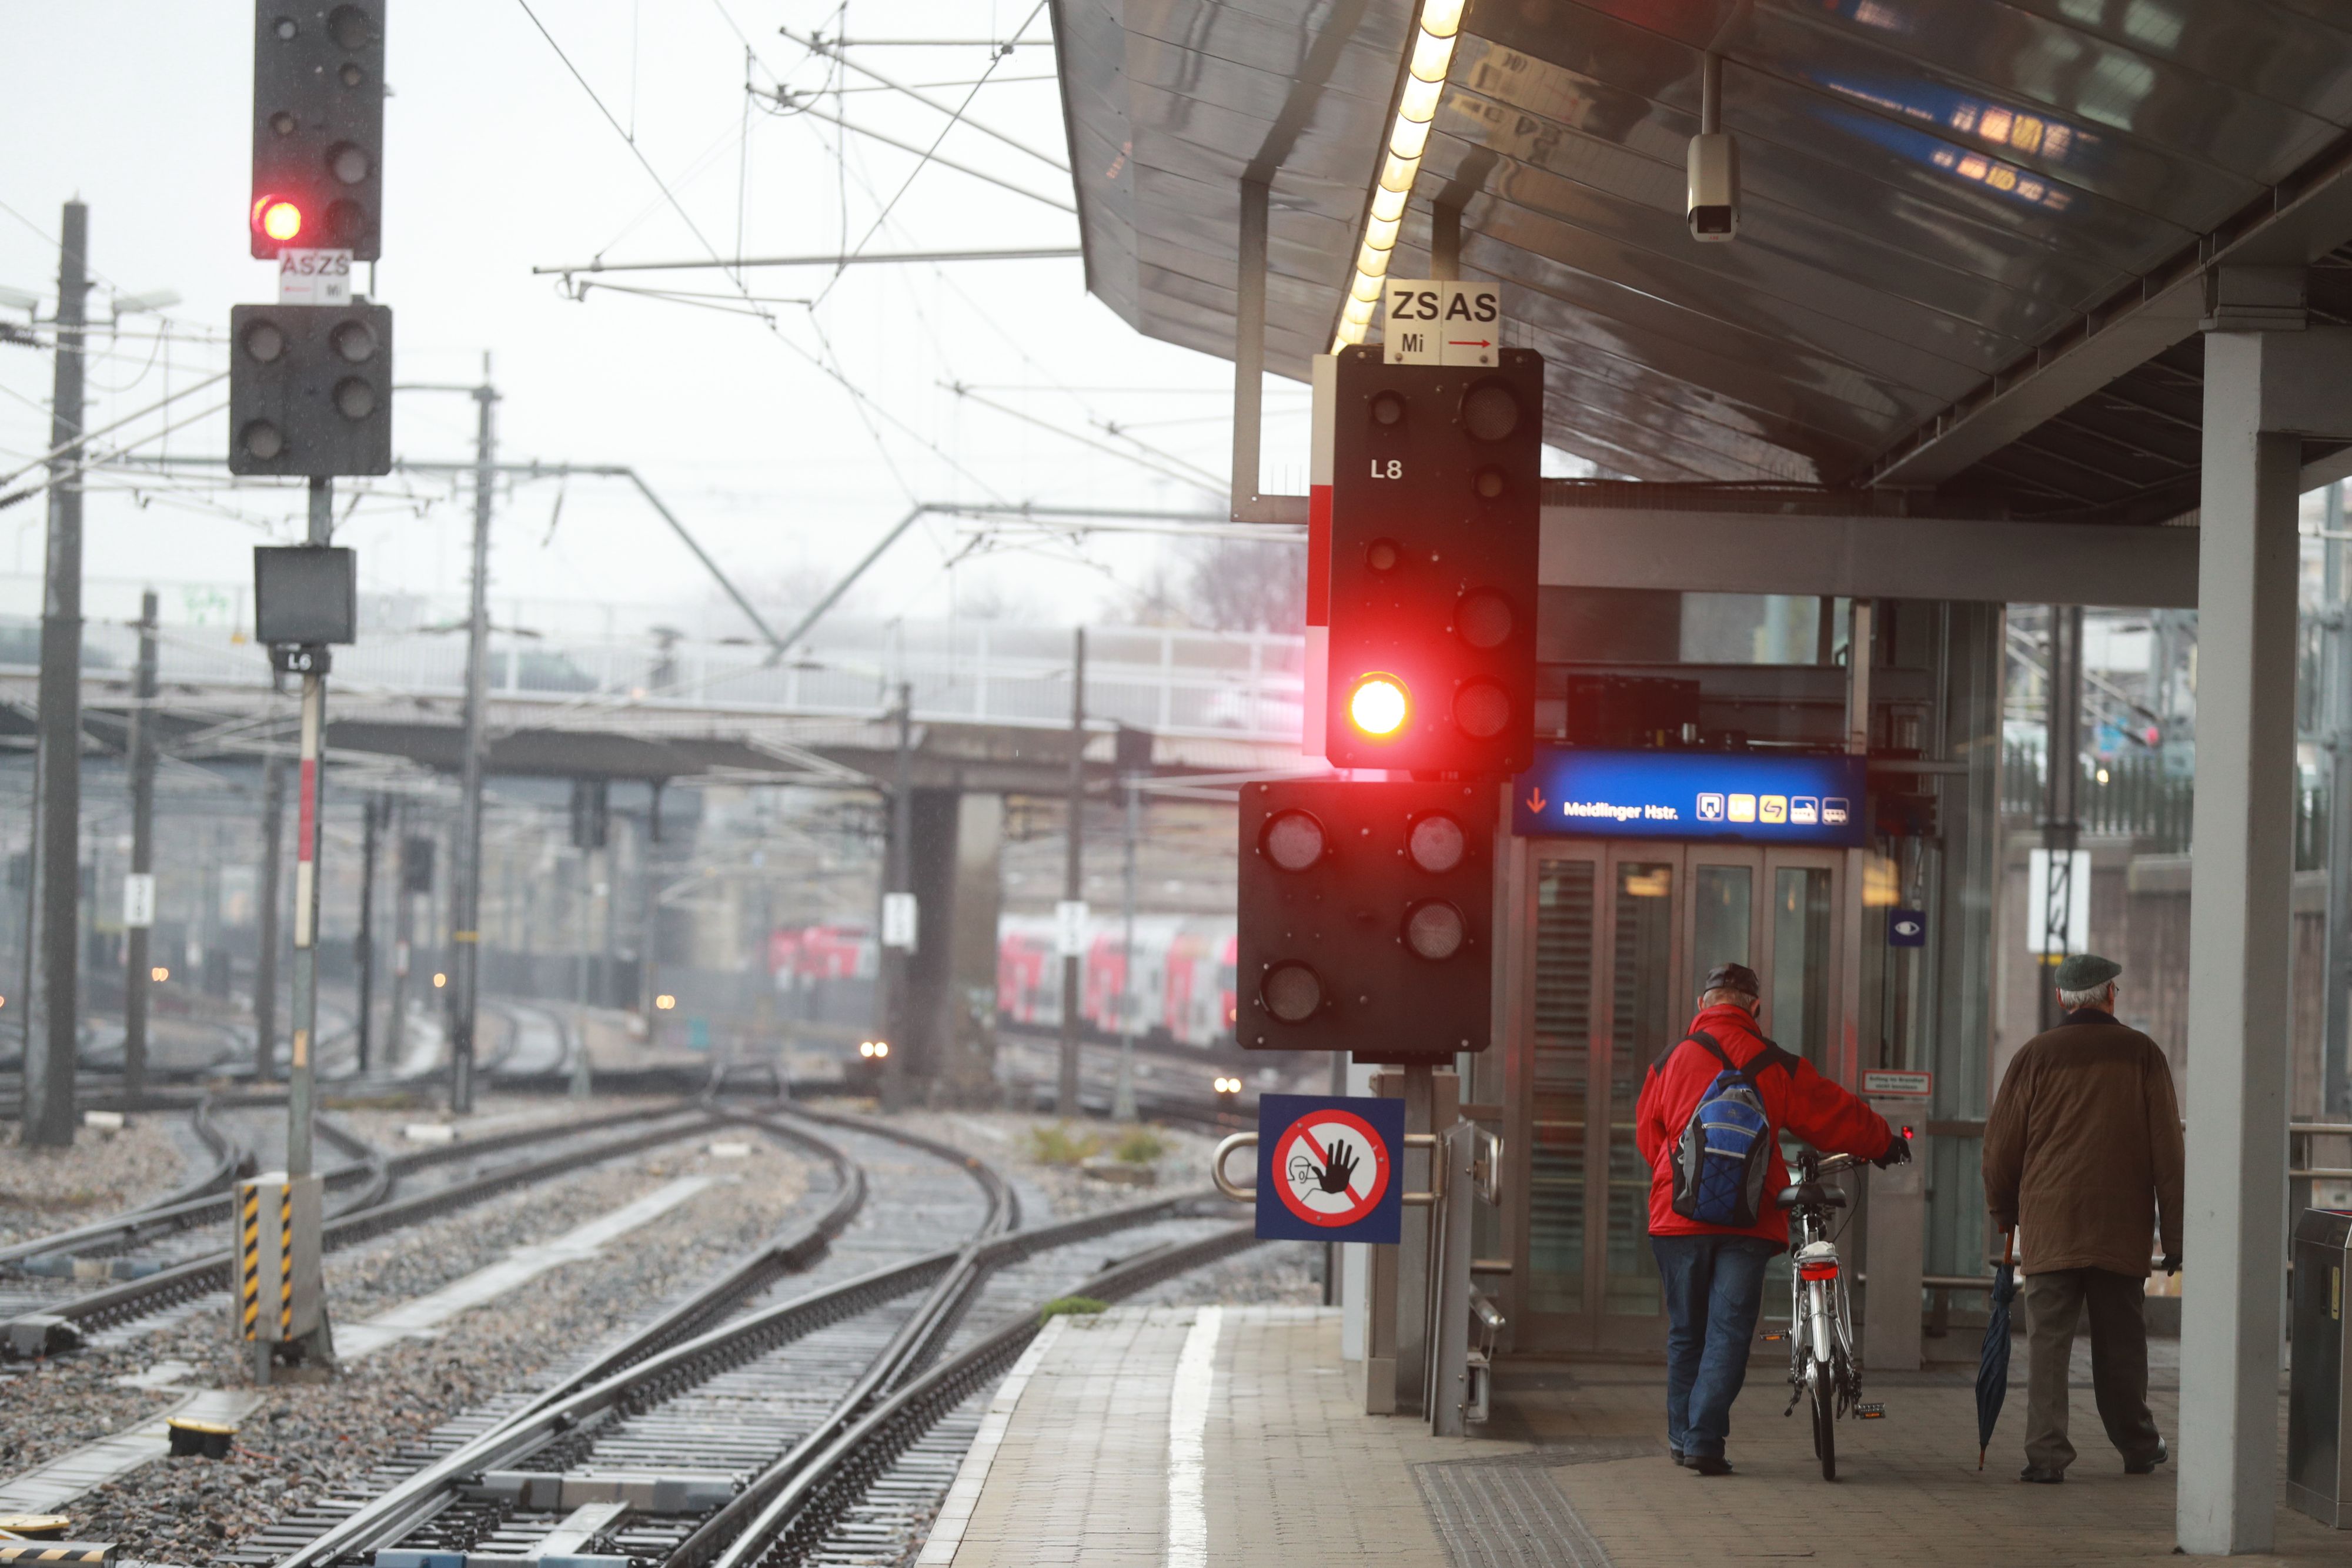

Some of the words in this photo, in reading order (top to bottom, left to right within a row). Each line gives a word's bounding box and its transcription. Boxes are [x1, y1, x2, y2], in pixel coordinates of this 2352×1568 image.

[1402, 333, 1424, 352] Mi
[1371, 460, 1402, 479] L8
[288, 653, 312, 670] L6
[1563, 801, 1642, 821] Meidlinger
[1645, 804, 1678, 820] Hstr.
